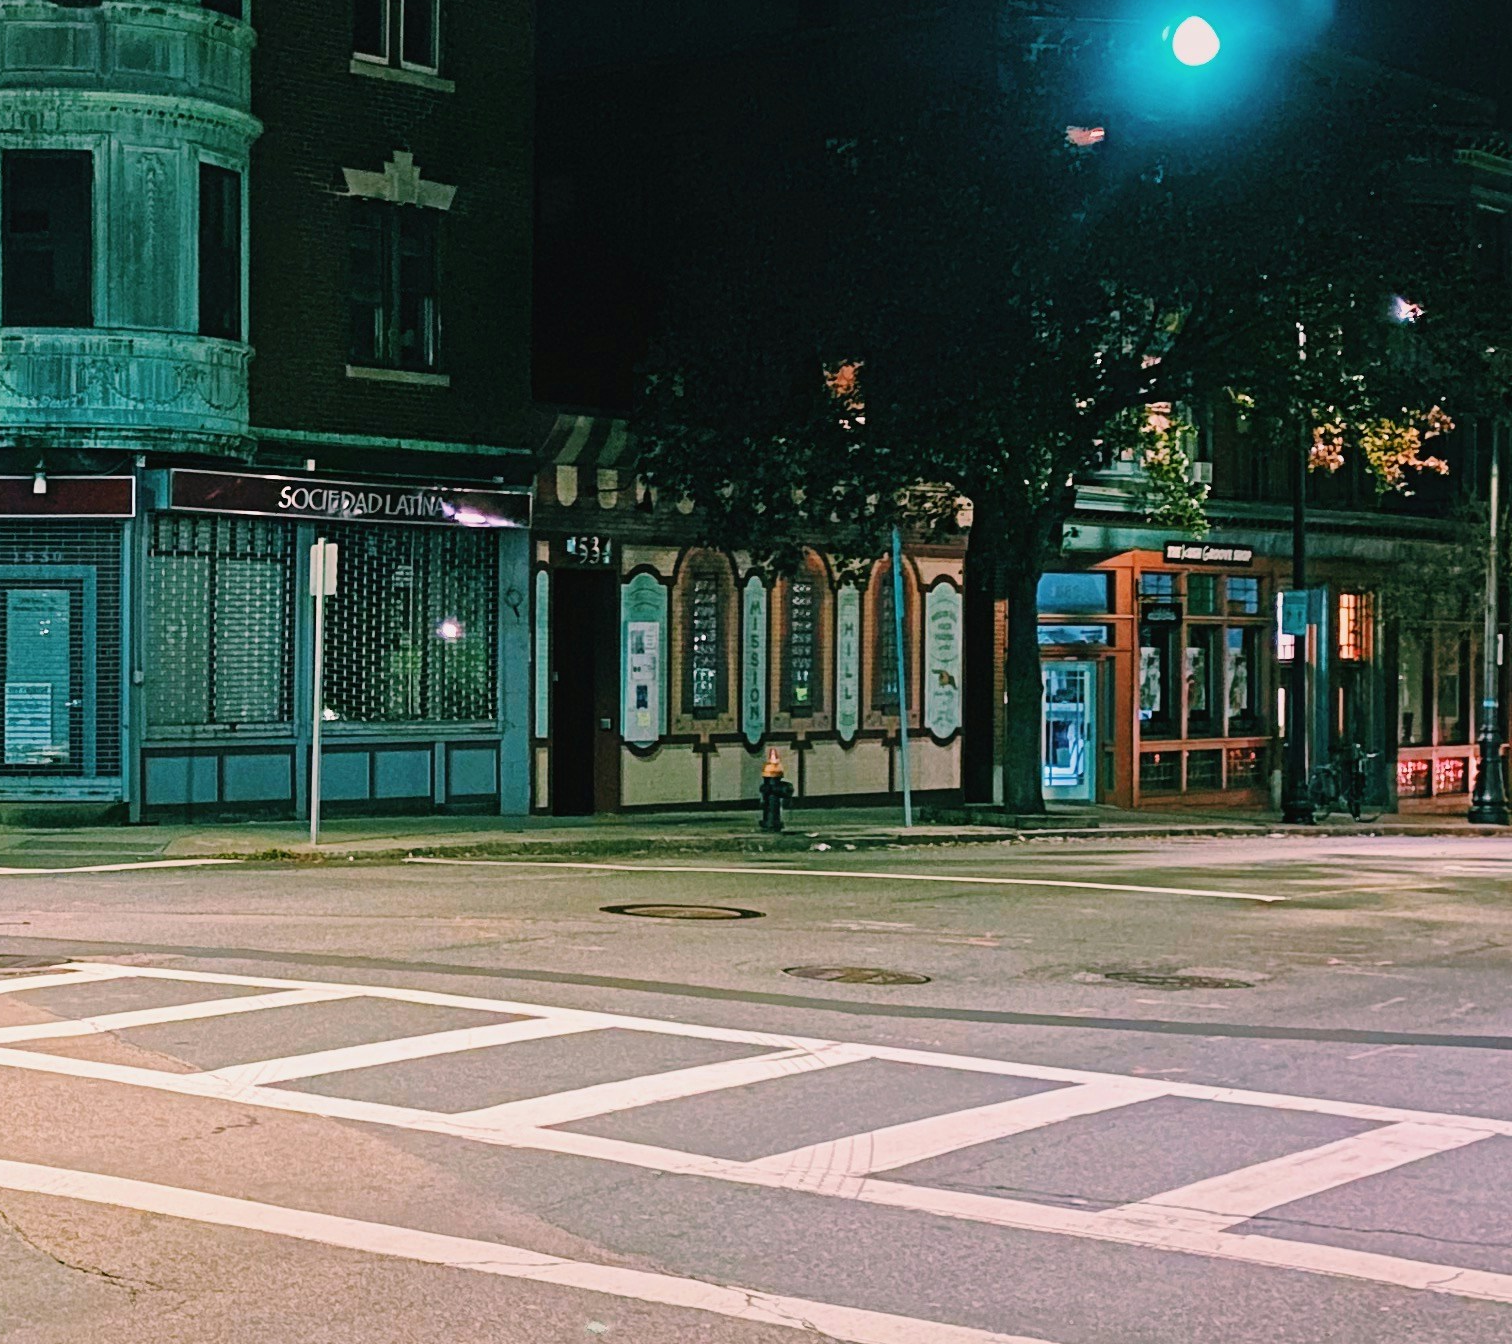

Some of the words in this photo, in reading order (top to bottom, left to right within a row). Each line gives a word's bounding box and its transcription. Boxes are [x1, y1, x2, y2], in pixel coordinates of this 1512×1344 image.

[278, 485, 383, 516] SOCIEDAD
[386, 493, 445, 517] LATINA
[749, 599, 761, 721] MISSION
[844, 622, 854, 700] HILL
